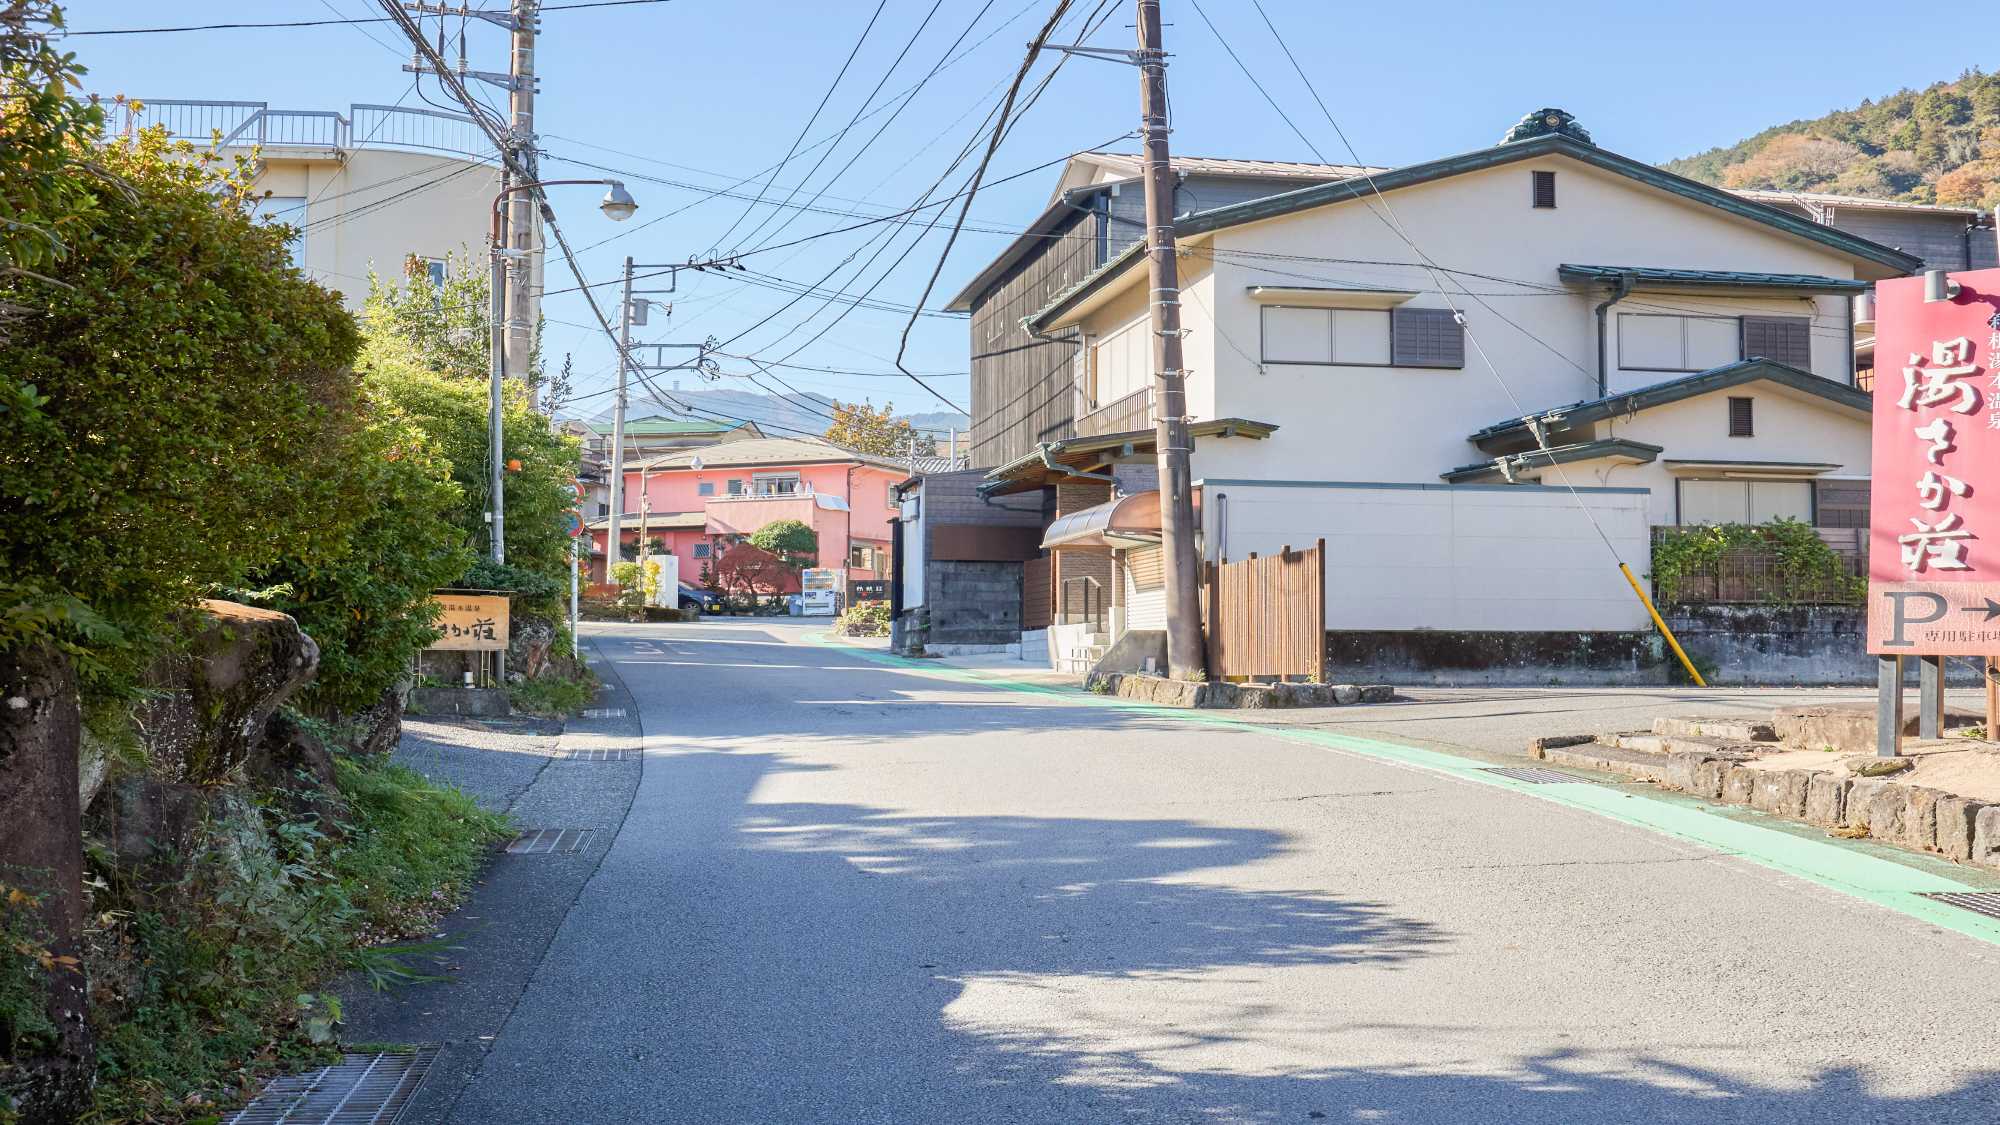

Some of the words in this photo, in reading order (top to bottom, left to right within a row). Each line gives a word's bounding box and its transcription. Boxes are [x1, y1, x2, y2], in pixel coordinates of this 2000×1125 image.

[1896, 336, 1978, 571] 湯さか荘
[1882, 591, 1949, 647] P
